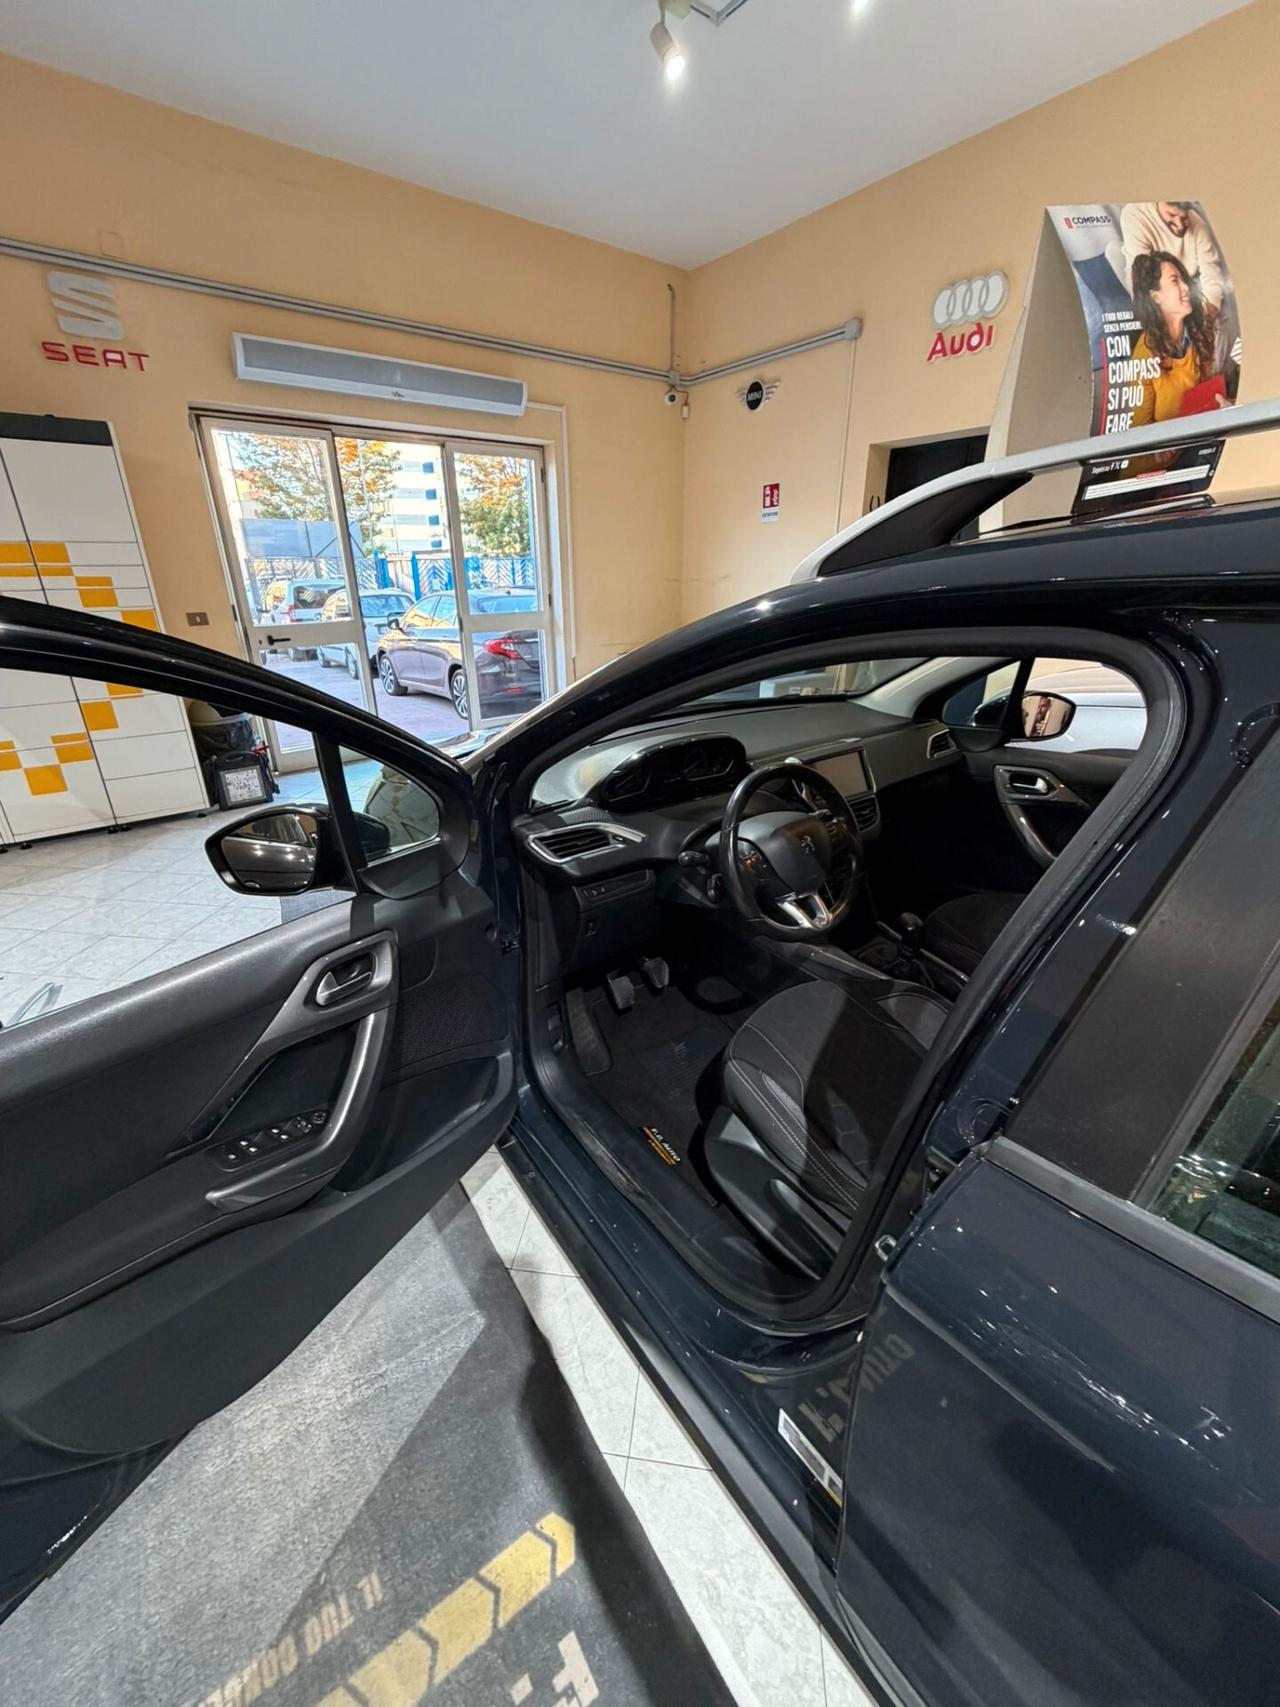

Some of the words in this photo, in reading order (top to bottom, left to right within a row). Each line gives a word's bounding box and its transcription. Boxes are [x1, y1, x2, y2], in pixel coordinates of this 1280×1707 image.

[1072, 215, 1111, 225] COMPASS
[1103, 323, 1119, 333] SENZA
[1105, 312, 1116, 322] TUOI
[926, 322, 993, 361] Audi
[1106, 335, 1131, 358] CON
[41, 341, 149, 371] SEAT
[1108, 356, 1161, 384] COMPASS
[1107, 388, 1119, 411] SI
[1121, 380, 1144, 409] PUÒ
[1105, 411, 1134, 435] FARE
[304, 1592, 355, 1655] TUO
